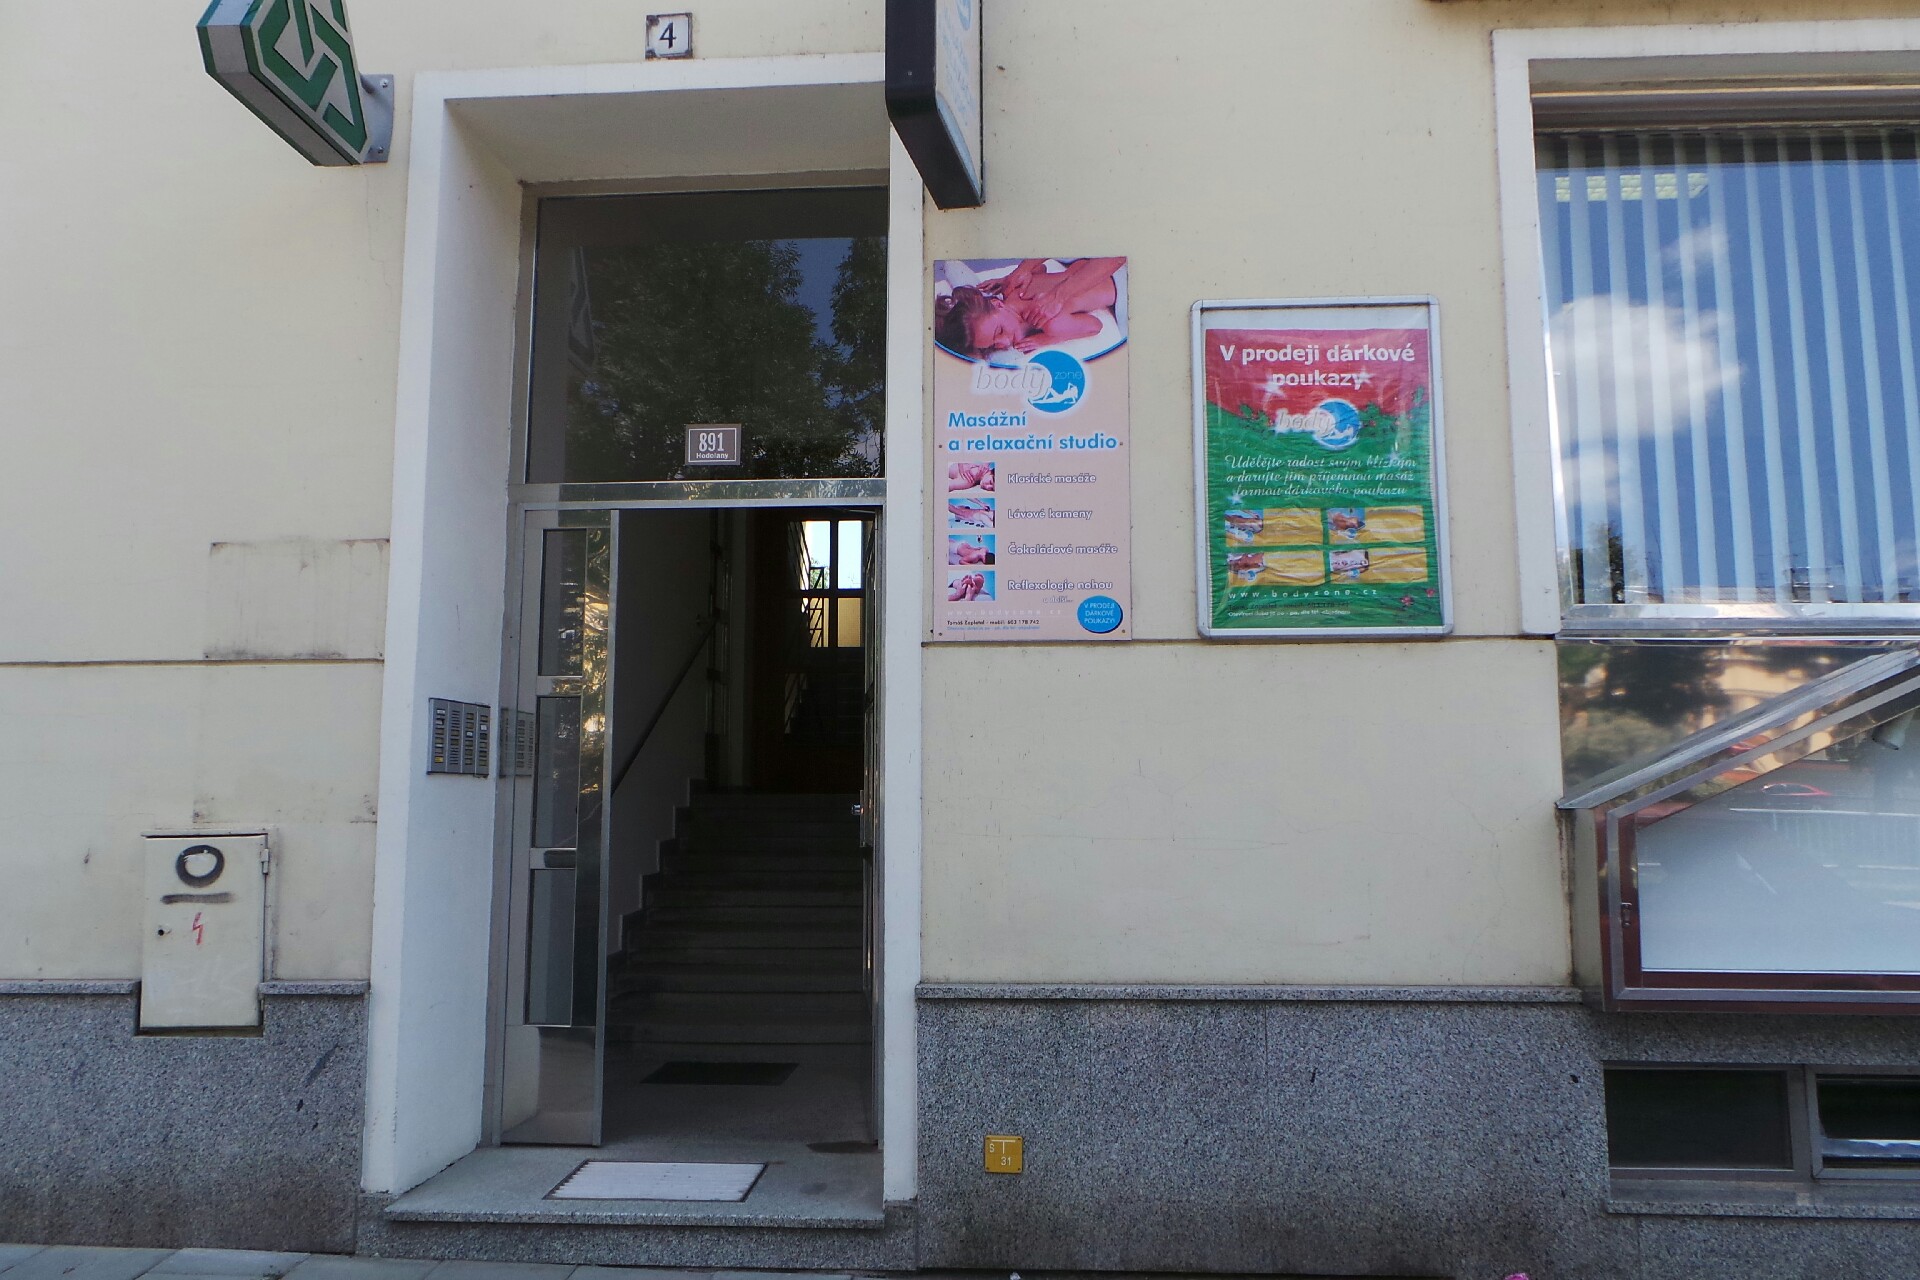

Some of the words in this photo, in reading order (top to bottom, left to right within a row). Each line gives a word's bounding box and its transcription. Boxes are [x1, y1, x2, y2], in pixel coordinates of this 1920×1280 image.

[659, 21, 677, 49] 4
[1219, 345, 1236, 361] V
[1242, 345, 1320, 365] prodeji
[1327, 343, 1415, 362] dárkové
[976, 366, 1048, 398] body
[1271, 370, 1362, 390] poukazy
[948, 411, 1026, 428] Masážní
[699, 432, 724, 452] 891
[948, 440, 960, 451] a
[967, 434, 1052, 450] relaxační
[1059, 433, 1118, 449] studio
[1288, 455, 1325, 467] radost
[1008, 473, 1052, 484] Klasické
[1055, 473, 1096, 483] masáže
[1226, 474, 1236, 483] a
[1238, 470, 1281, 485] darujte
[1008, 508, 1046, 519] Lávové
[1048, 508, 1092, 520] kameny
[1008, 542, 1073, 554] Čokoládové
[1076, 543, 1118, 554] masáže
[1008, 579, 1074, 592] Reflexologie
[1077, 580, 1112, 589] nohou
[1001, 1156, 1011, 1166] 31
